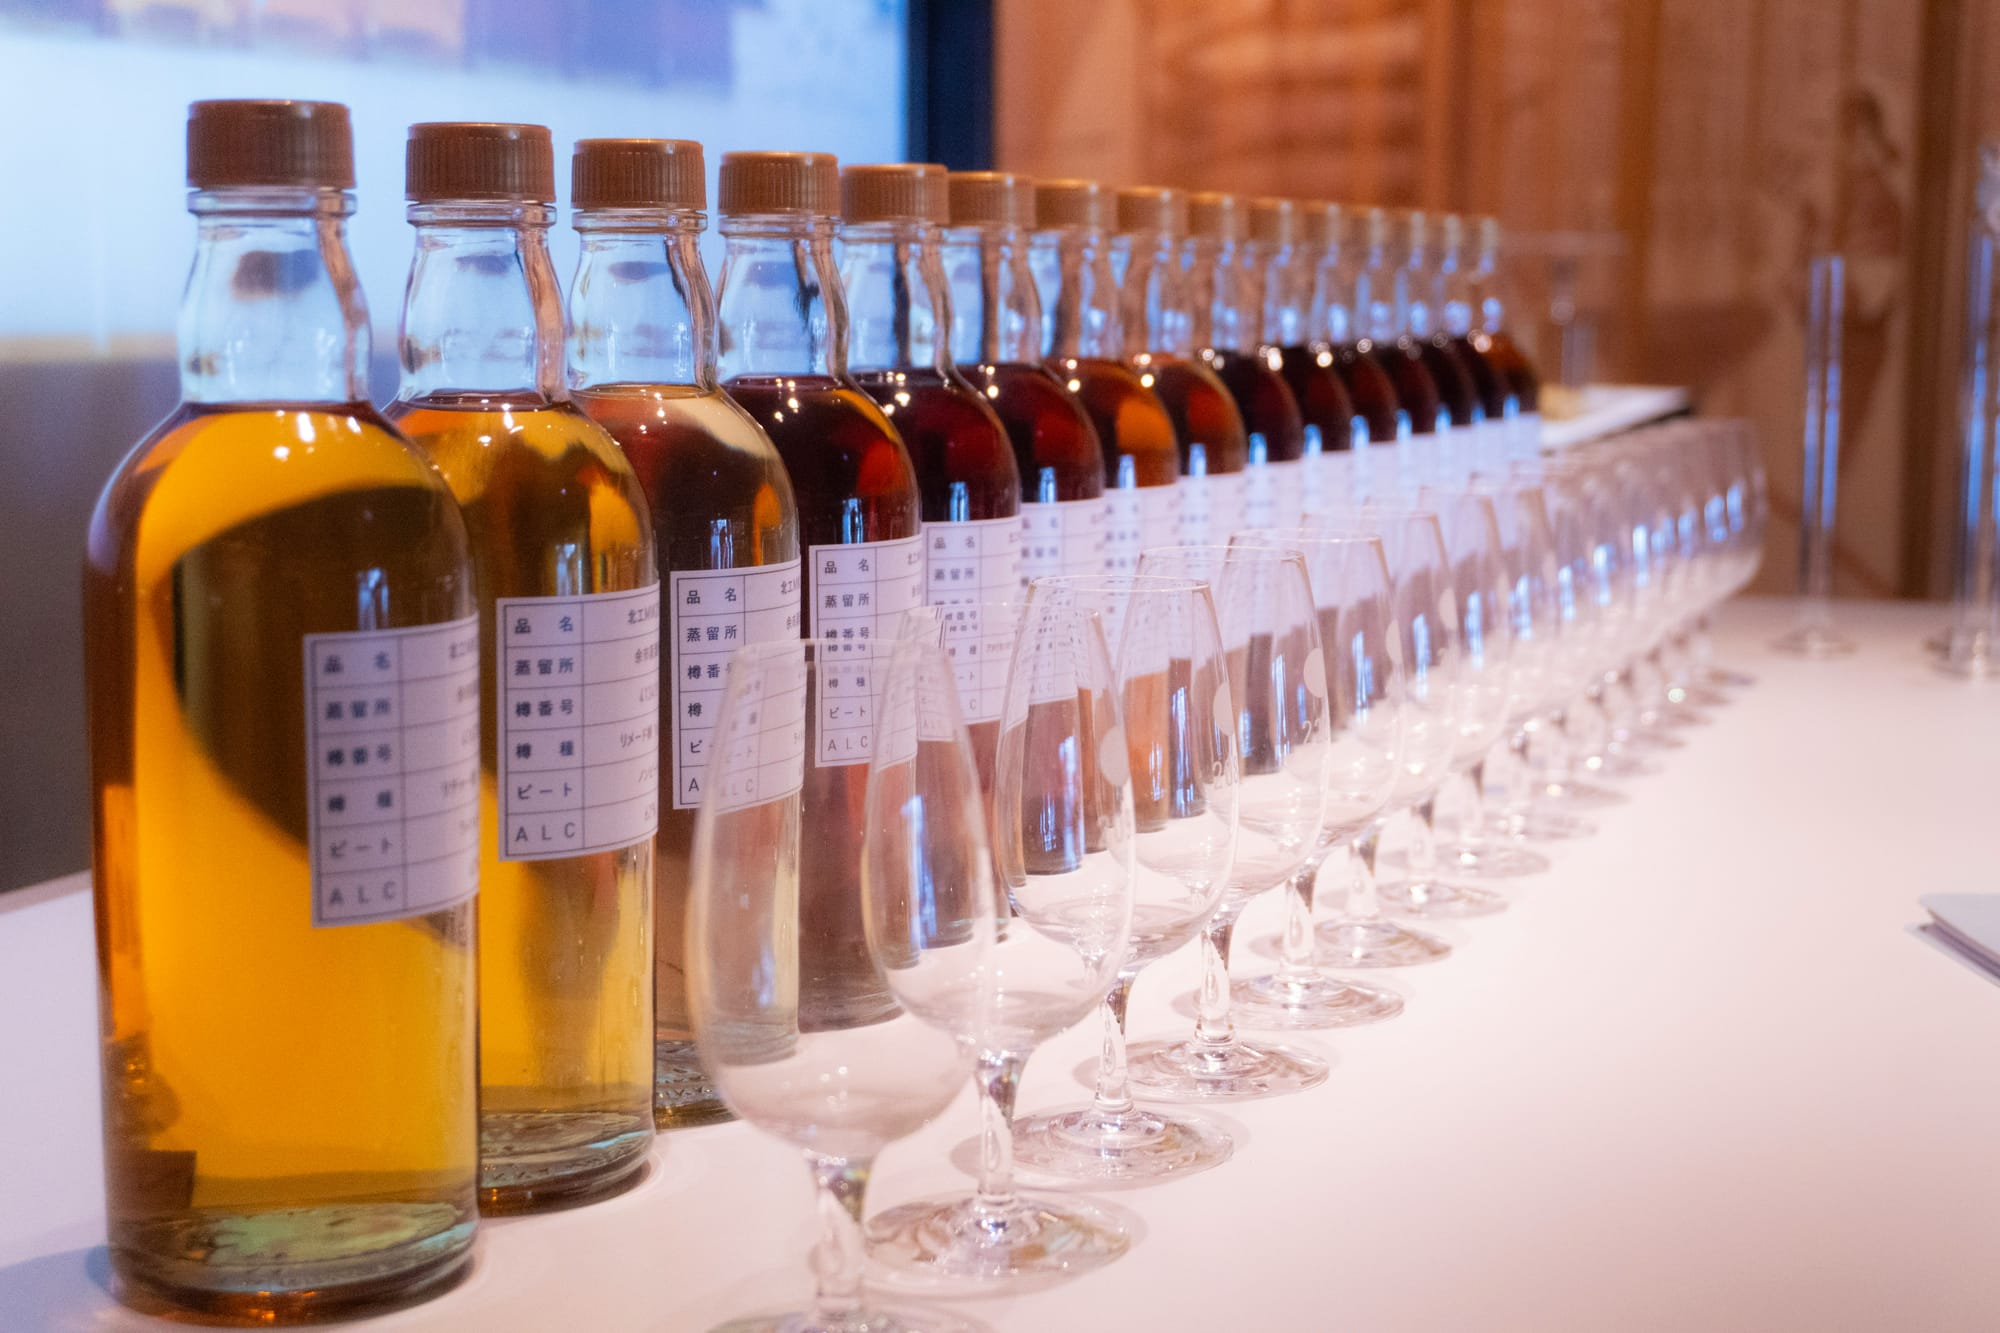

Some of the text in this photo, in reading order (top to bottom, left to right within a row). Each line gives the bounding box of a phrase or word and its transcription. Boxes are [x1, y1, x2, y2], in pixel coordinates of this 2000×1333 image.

[825, 594, 870, 609] 蒸留所
[686, 625, 738, 642] 蒸留所
[515, 658, 574, 677] 蒸留所
[516, 699, 574, 717] 樽番号
